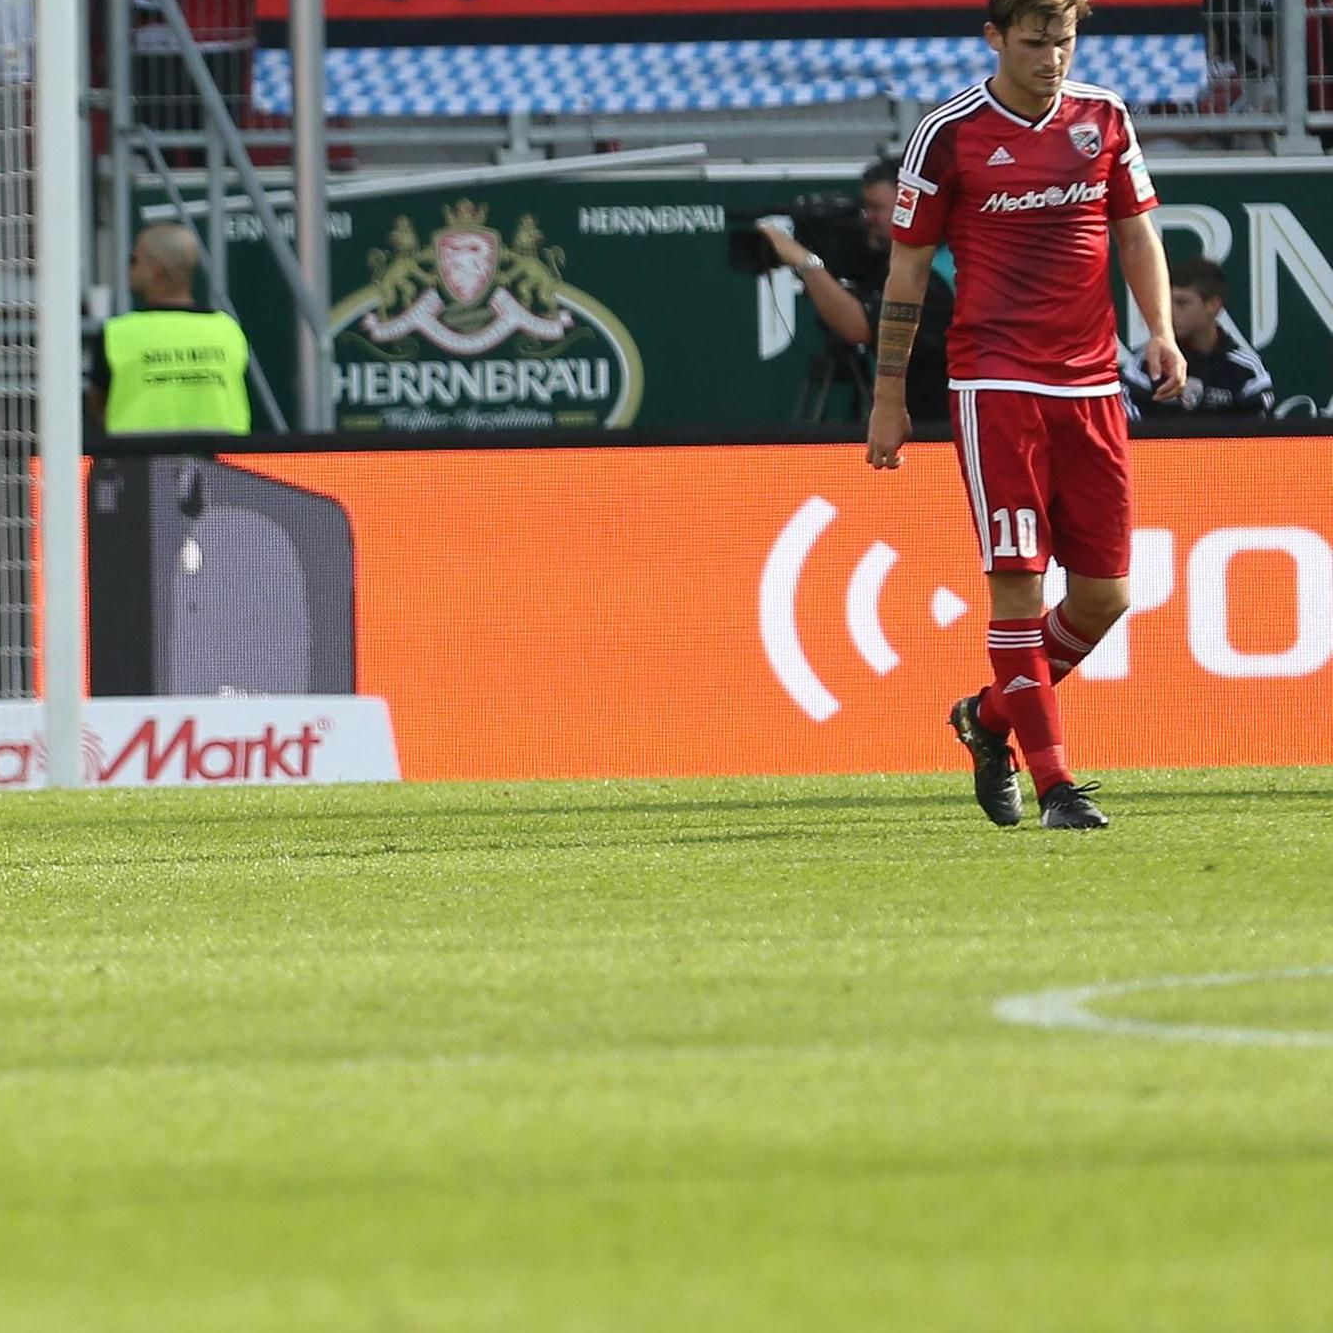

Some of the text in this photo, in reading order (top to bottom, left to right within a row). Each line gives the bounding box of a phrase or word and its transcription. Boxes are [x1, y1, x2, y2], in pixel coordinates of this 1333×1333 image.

[981, 192, 1044, 213] Media
[332, 356, 611, 405] HERRNBRÄU
[992, 507, 1038, 558] 10
[98, 717, 323, 783] Markt
